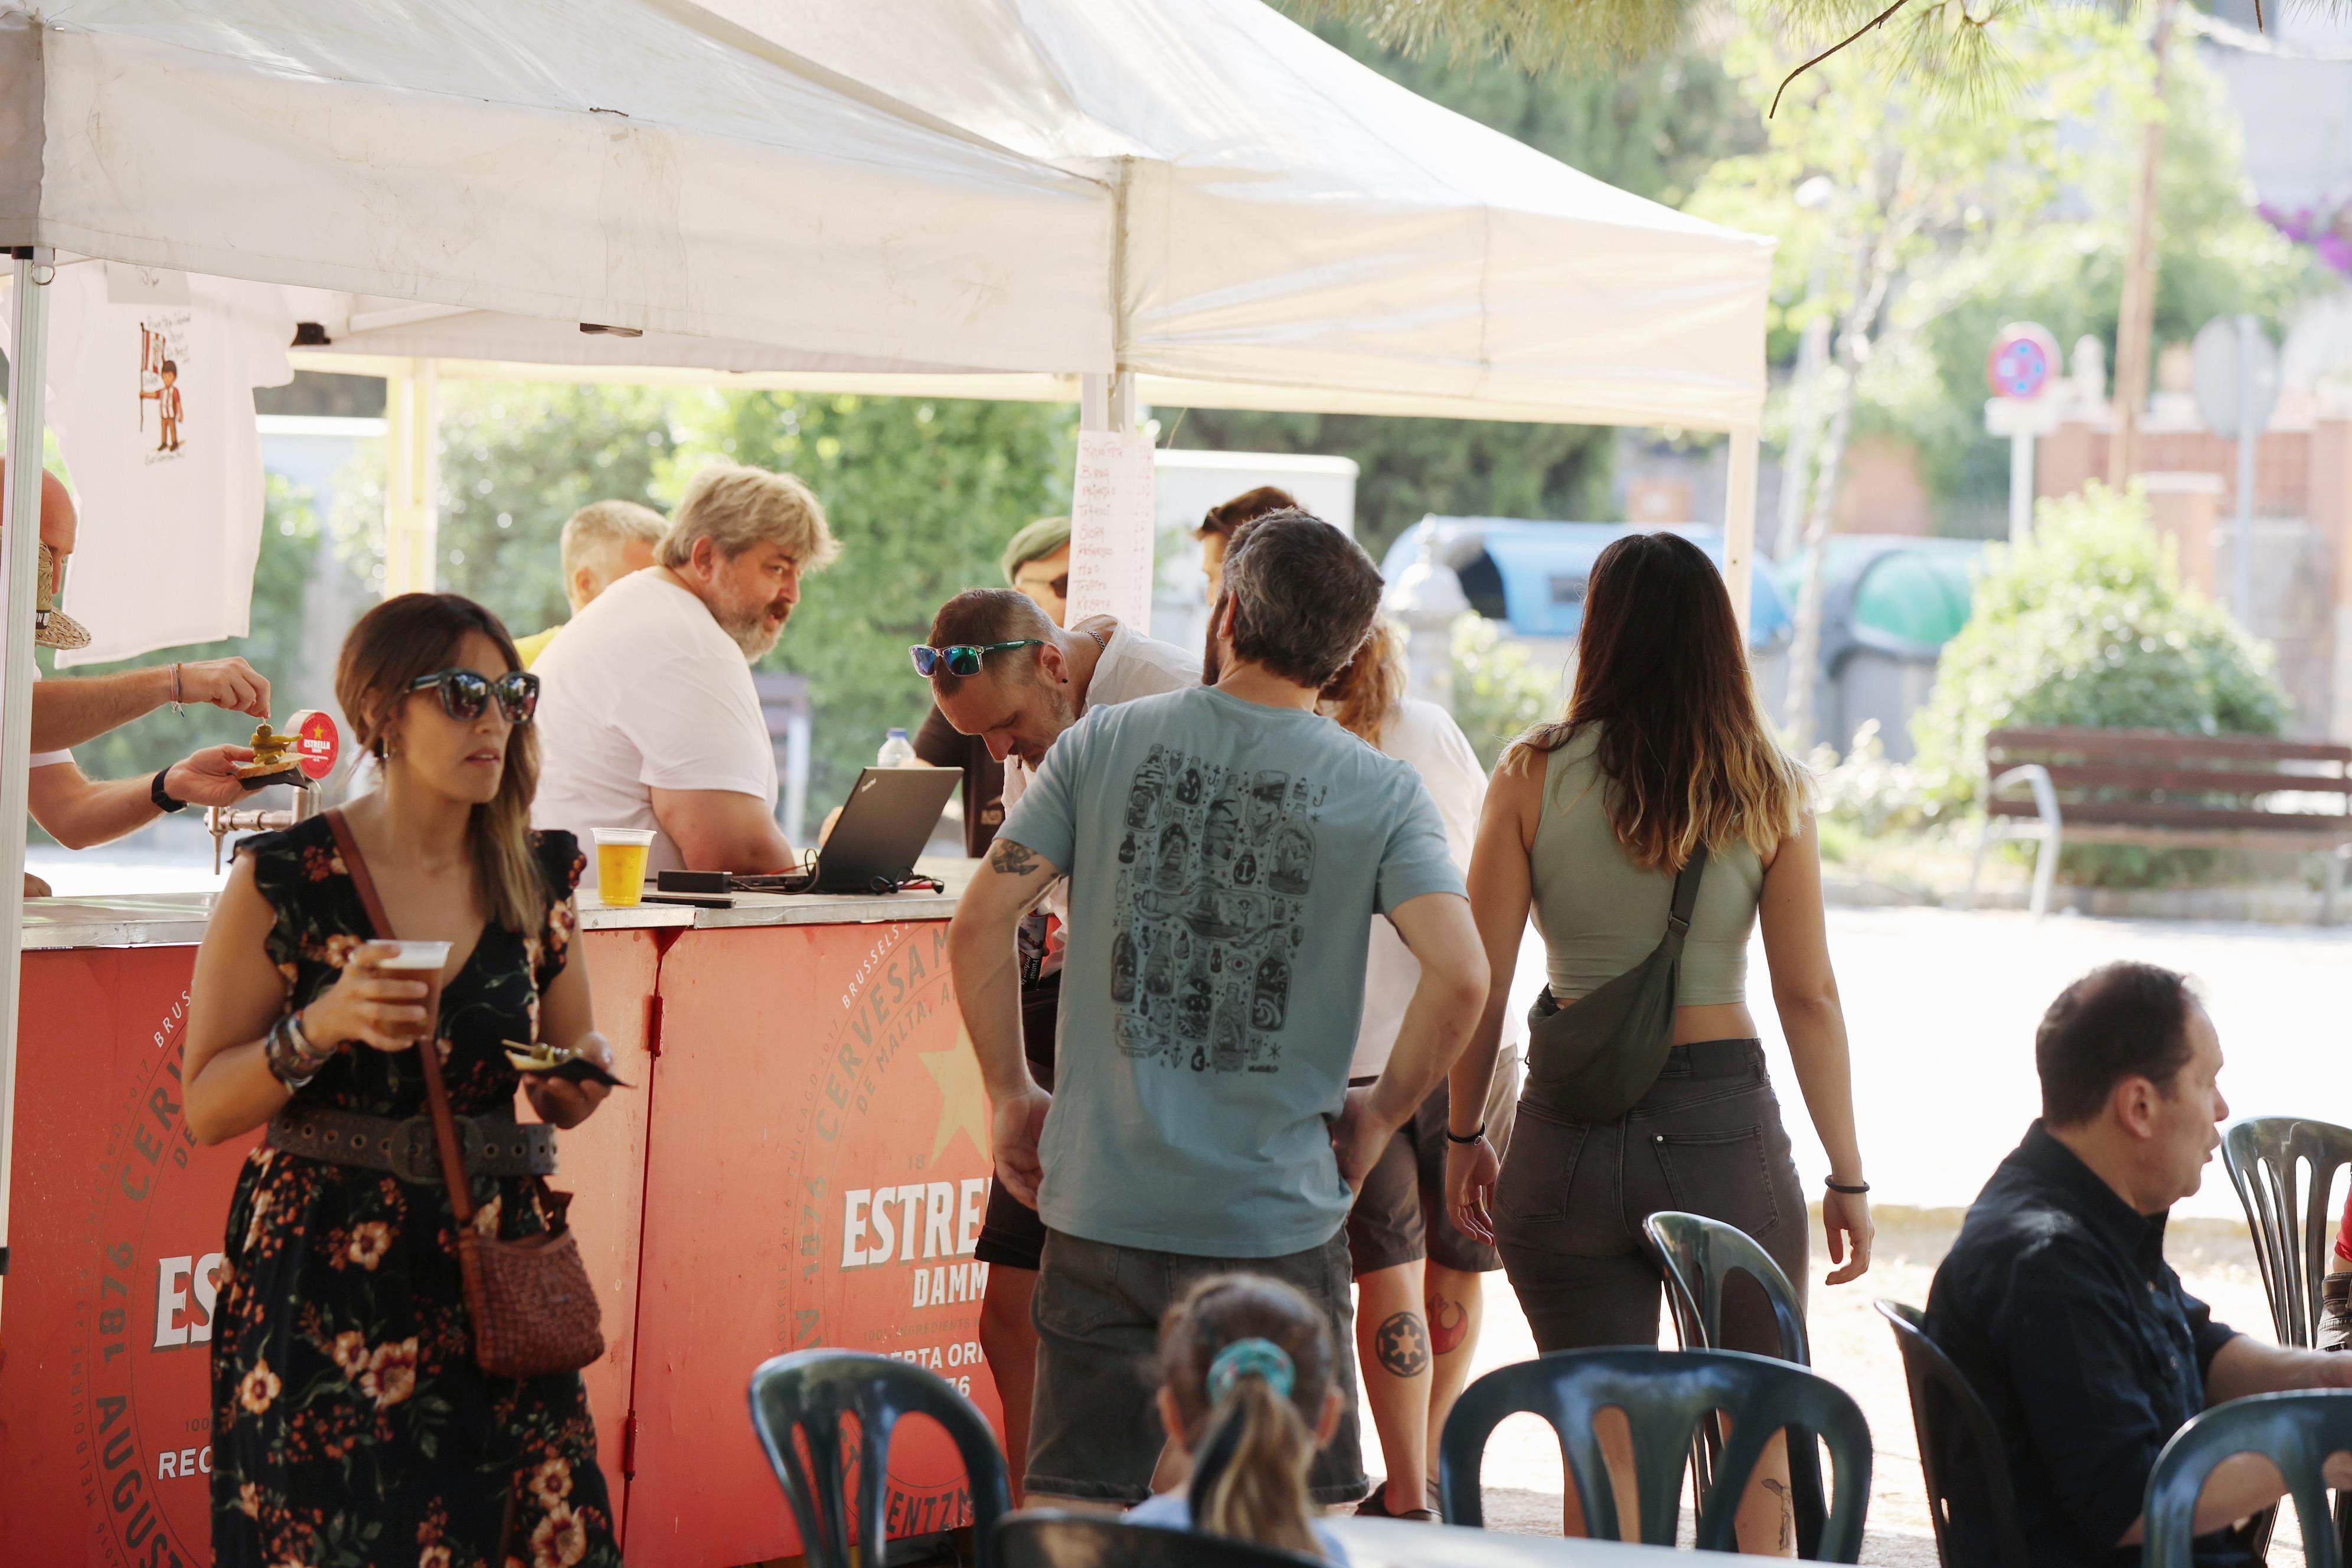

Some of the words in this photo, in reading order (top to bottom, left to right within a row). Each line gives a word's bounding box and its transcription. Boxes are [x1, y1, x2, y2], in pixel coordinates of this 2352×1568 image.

[842, 924, 899, 1010] BRUSSELS
[153, 979, 194, 1048] BRUS
[815, 943, 926, 1142] CERVESA
[122, 1059, 150, 1115] 2017
[787, 1073, 819, 1178] CHICAGO
[855, 1076, 876, 1115] DE
[801, 1176, 827, 1283] 1876
[841, 1177, 993, 1269] ESTRE
[99, 1241, 134, 1364] 1876
[913, 1262, 989, 1308] DAMM
[69, 1344, 97, 1508] MELBOURNE
